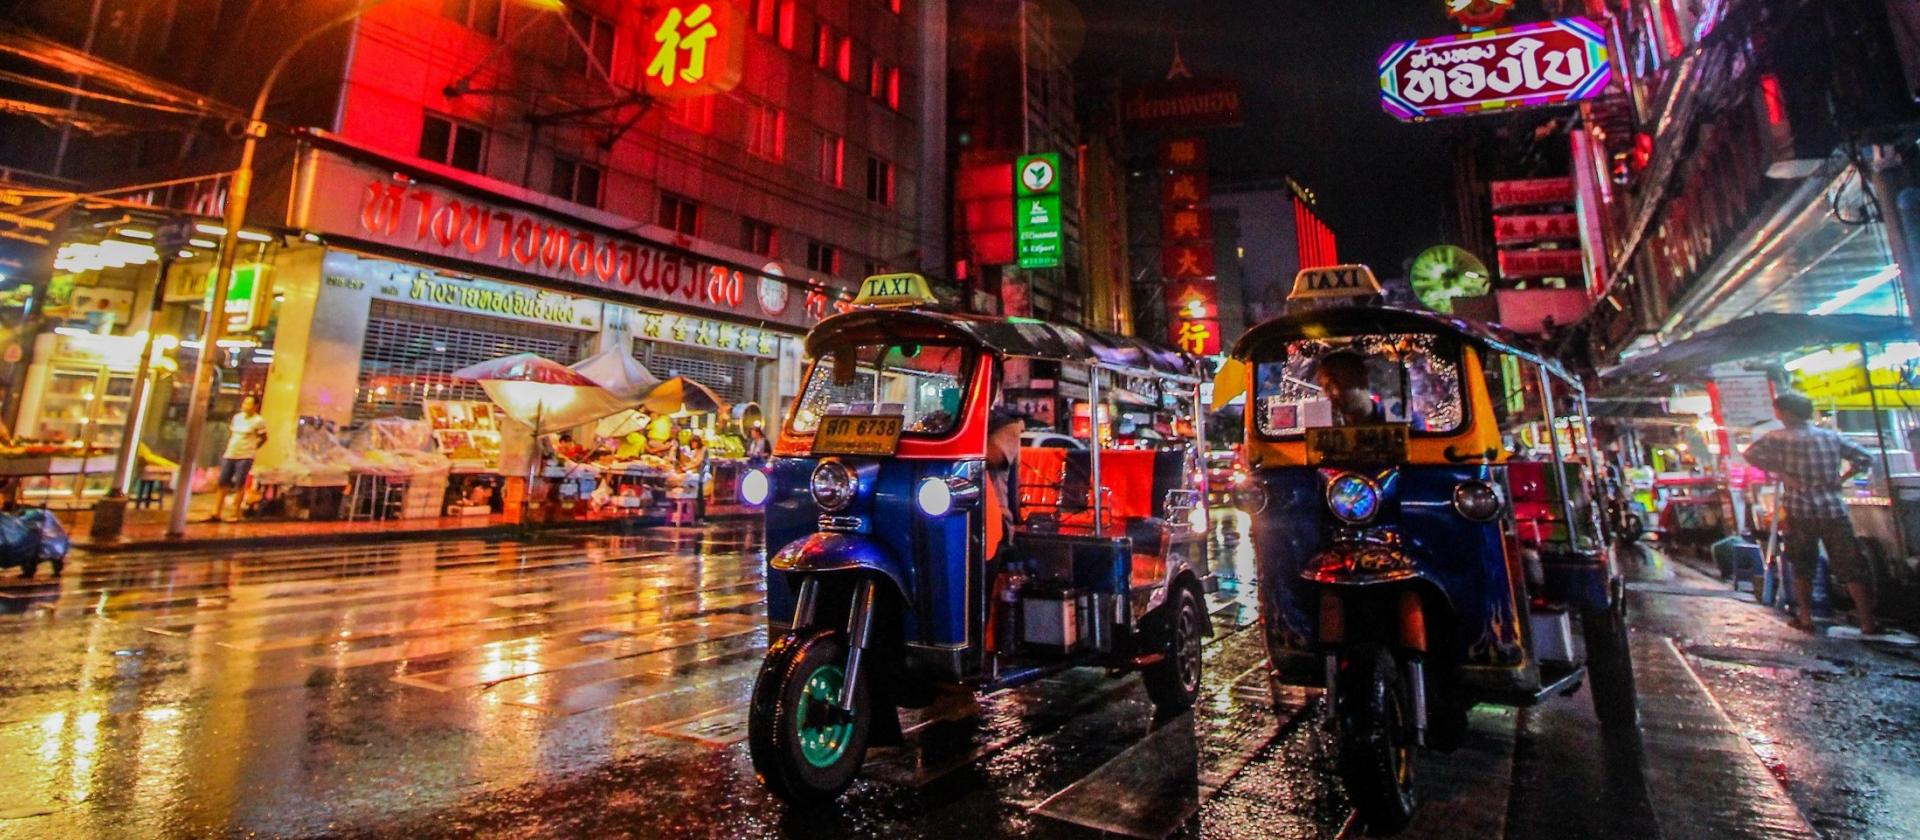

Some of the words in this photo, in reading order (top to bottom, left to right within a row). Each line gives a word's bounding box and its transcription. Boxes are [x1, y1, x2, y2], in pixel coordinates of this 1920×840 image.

[646, 3, 718, 87] 行
[1402, 37, 1585, 103] ทองใบ
[868, 277, 912, 297] TAXI
[1306, 270, 1361, 289] TAXI
[856, 419, 897, 437] 6738
